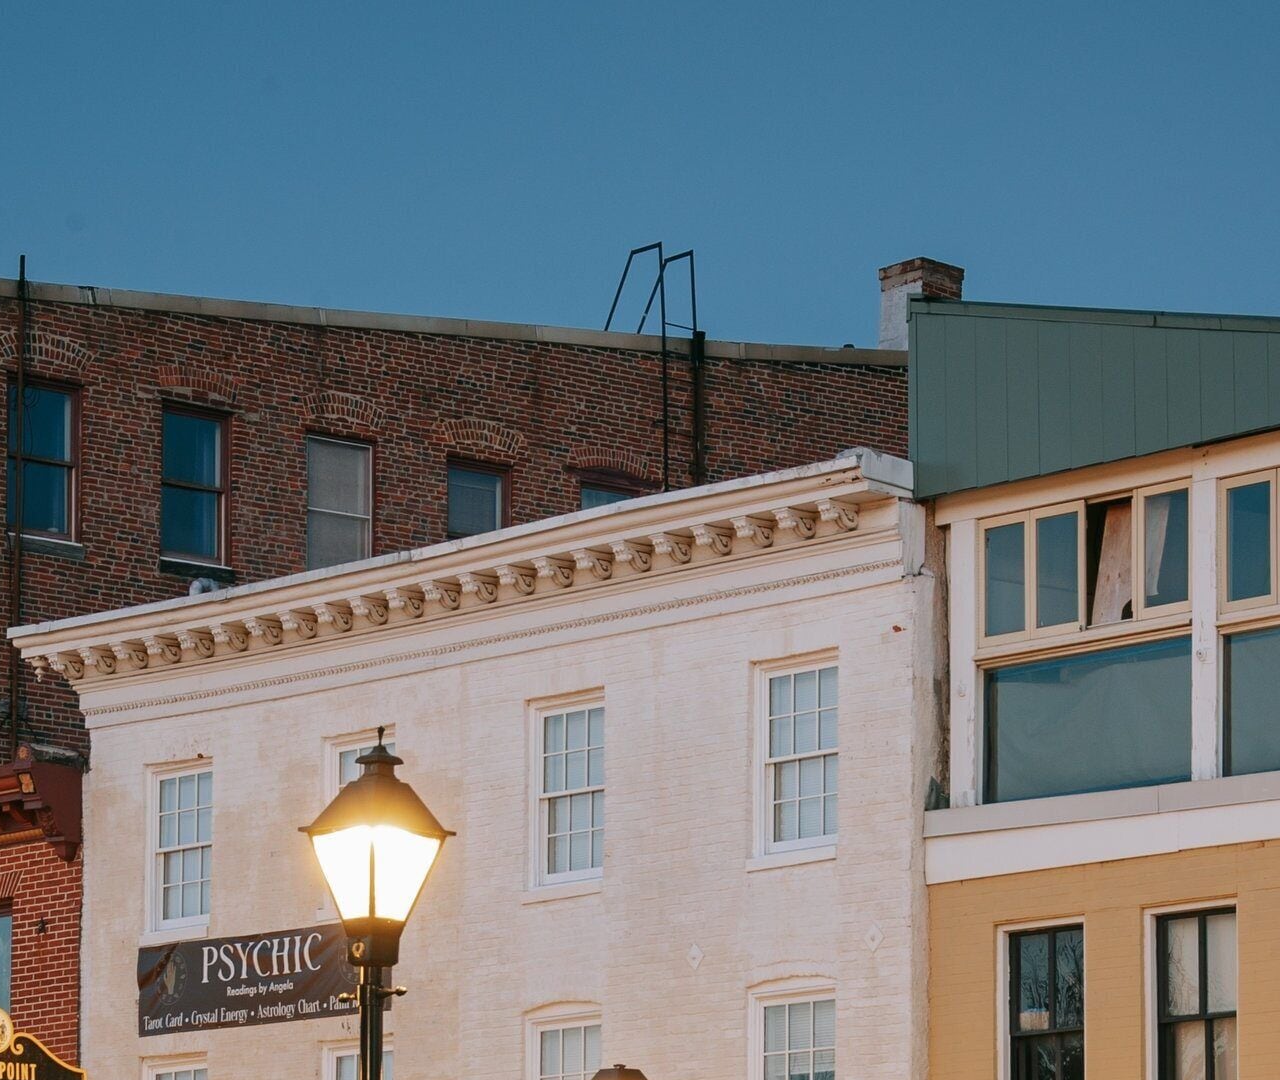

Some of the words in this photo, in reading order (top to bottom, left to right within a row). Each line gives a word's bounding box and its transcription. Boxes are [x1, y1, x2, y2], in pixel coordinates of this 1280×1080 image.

[201, 933, 322, 984] PSYCHIC
[227, 984, 257, 997] Readings
[259, 983, 267, 995] by
[269, 979, 293, 993] Angela
[143, 1016, 163, 1030] Tarot
[165, 1013, 183, 1028] Card
[191, 1009, 218, 1027] Crystal
[220, 1008, 249, 1023] Energy
[257, 1002, 296, 1018] Astrology
[298, 999, 320, 1014] Chart
